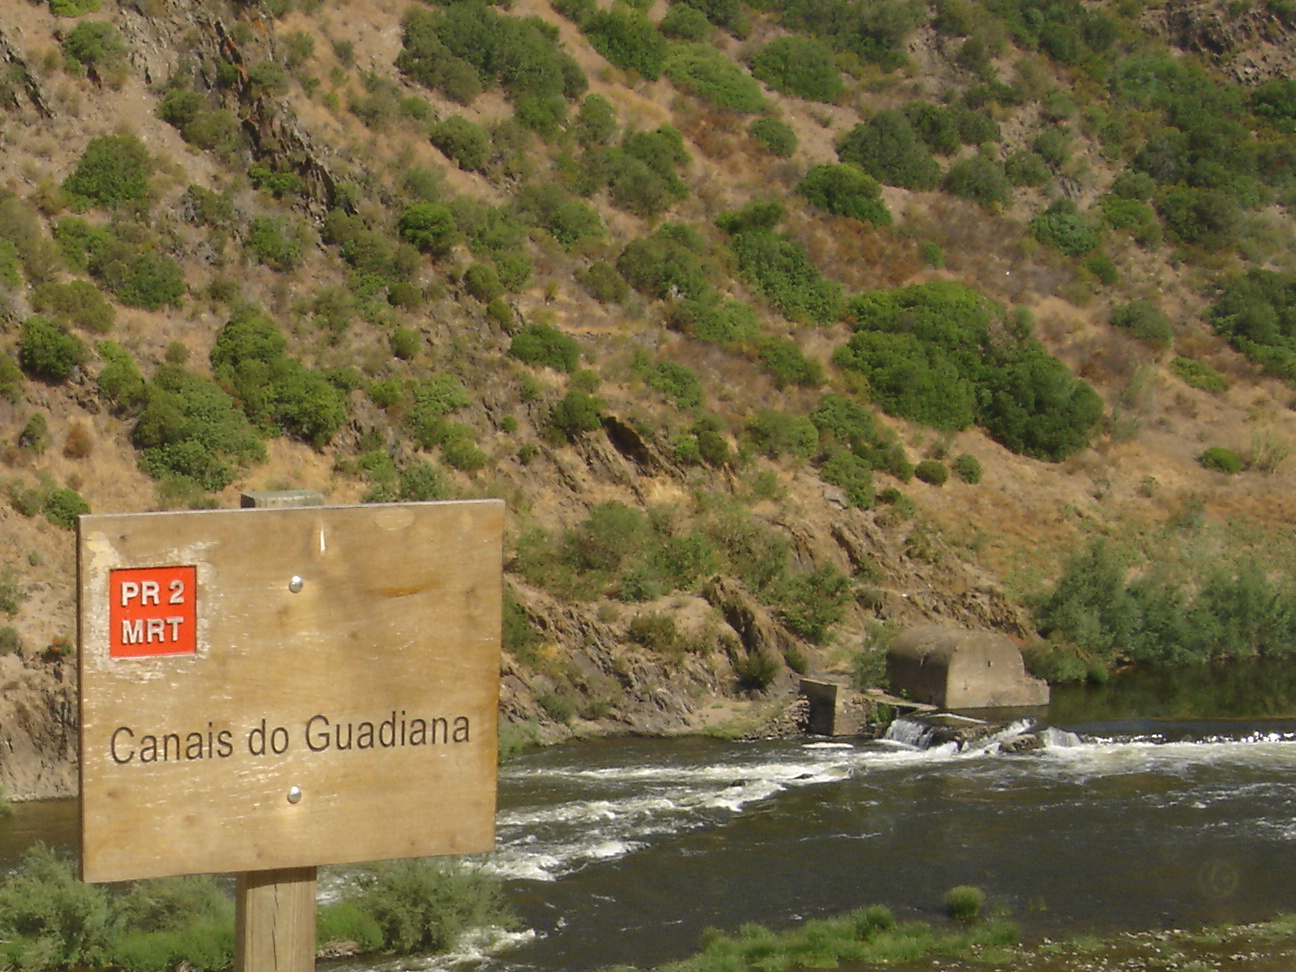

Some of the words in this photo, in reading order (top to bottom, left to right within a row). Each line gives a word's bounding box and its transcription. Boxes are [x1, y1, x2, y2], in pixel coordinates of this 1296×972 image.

[121, 581, 161, 607] PR
[169, 580, 186, 605] 2
[121, 616, 185, 645] MRT
[110, 721, 234, 764] Canais
[248, 718, 290, 756] do
[304, 710, 472, 753] Guadiana
